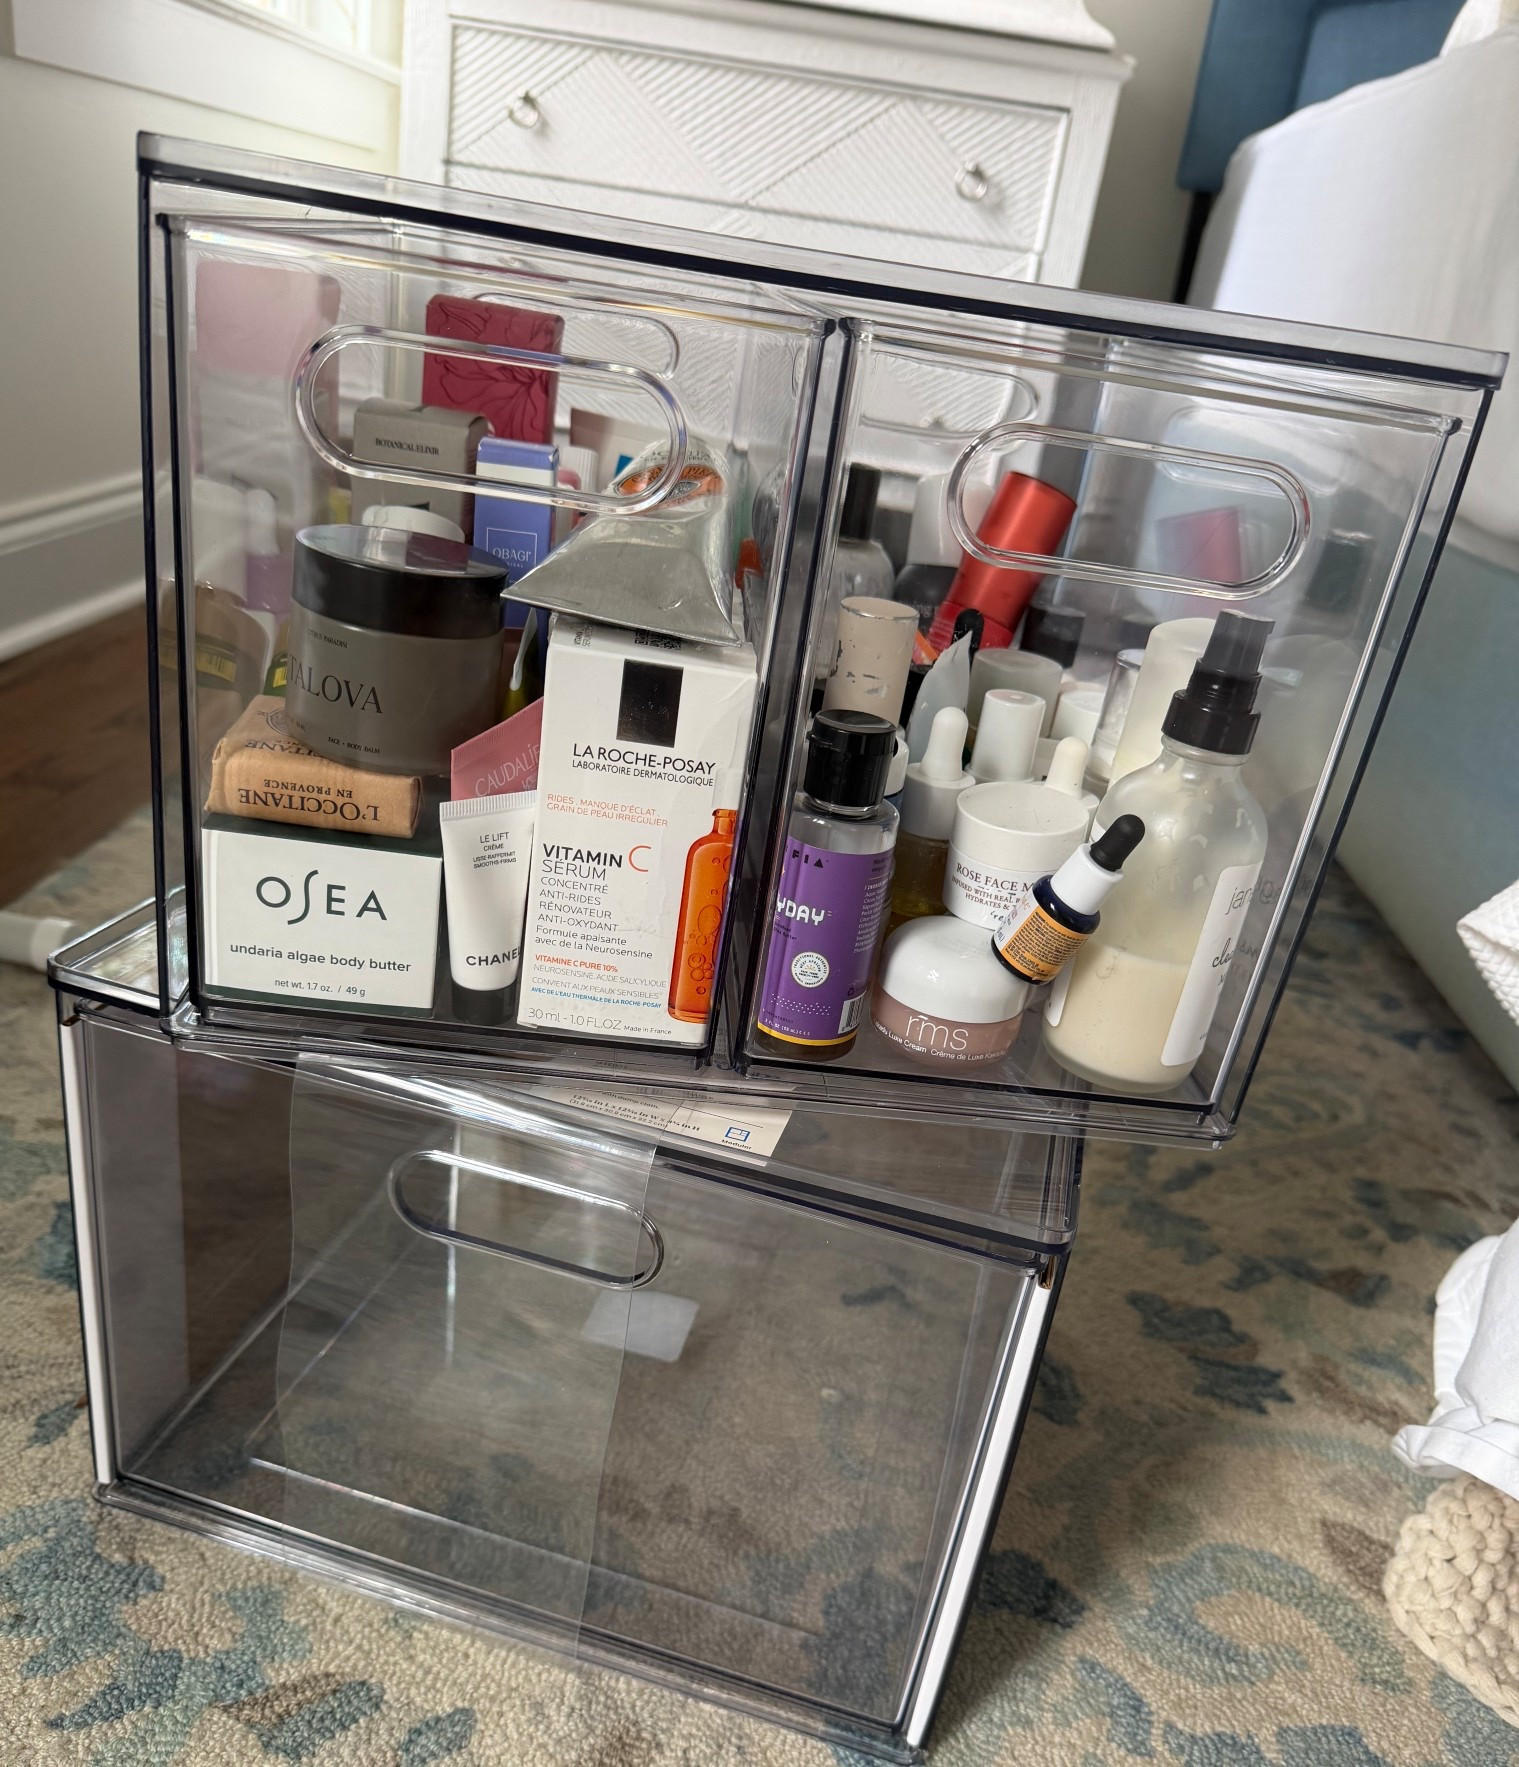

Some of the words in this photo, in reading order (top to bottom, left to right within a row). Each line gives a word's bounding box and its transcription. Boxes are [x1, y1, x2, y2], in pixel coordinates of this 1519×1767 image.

[375, 438, 416, 452] BOTANICAL
[573, 743, 594, 760] LA
[597, 747, 716, 775] ROCHE-POSAY
[572, 759, 631, 776] LABORATOIRE
[633, 768, 714, 787] DERMATOLOGIQUE
[263, 778, 332, 796] PROVENCE
[336, 789, 353, 799] EN
[238, 787, 380, 822] L'OCCITANE
[546, 802, 575, 815] GRAIN
[576, 806, 589, 816] DE
[590, 809, 614, 820] PEAU
[547, 793, 574, 805] RIDES
[580, 798, 619, 812] MANQUE
[479, 834, 490, 844] LE
[492, 831, 510, 842] LIFT
[542, 843, 623, 868] VITAMIN
[628, 844, 651, 873] C
[541, 859, 606, 881] SÉRUM
[956, 862, 982, 883] ROSE
[984, 875, 1019, 892] FACE
[540, 876, 609, 894] CONCENTRÉ
[951, 875, 973, 892] INFUSED
[973, 887, 993, 899] WITH
[994, 893, 1014, 904] REAL
[255, 869, 388, 925] OSEA
[539, 889, 601, 906] ANTI-RIDES
[965, 892, 1001, 909] HYDRATES
[539, 900, 612, 919] RÉNOVATEUR
[537, 913, 619, 932] ANTI-OXYDANT
[536, 924, 578, 939] Formule
[580, 932, 627, 946] apaisante
[534, 936, 557, 946] avec
[559, 939, 571, 949] de
[574, 941, 583, 950] la
[585, 943, 653, 959] Neurosensine
[230, 943, 283, 959] undaria
[287, 950, 326, 964] algae
[330, 954, 366, 970] body
[369, 958, 412, 972] butter
[535, 954, 571, 966] VITAMINE
[573, 959, 579, 967] C
[580, 961, 602, 971] PURE
[602, 964, 618, 973] 10%
[532, 976, 571, 989] CONVIENT
[572, 983, 589, 991] AUX
[590, 985, 616, 996] PEAUX
[596, 973, 619, 982] ACIDE
[274, 978, 289, 988] net
[291, 980, 305, 990] wt.
[307, 982, 318, 991] 1.7
[320, 985, 333, 993] oz.
[346, 986, 357, 995] 49
[359, 988, 366, 997] g
[531, 986, 546, 994] AVEC
[620, 999, 662, 1008] ROCHE-POSAY
[528, 1007, 543, 1019] 30
[545, 1011, 560, 1022] ml
[570, 1014, 585, 1026] 1.0
[904, 1040, 927, 1053] Cream
